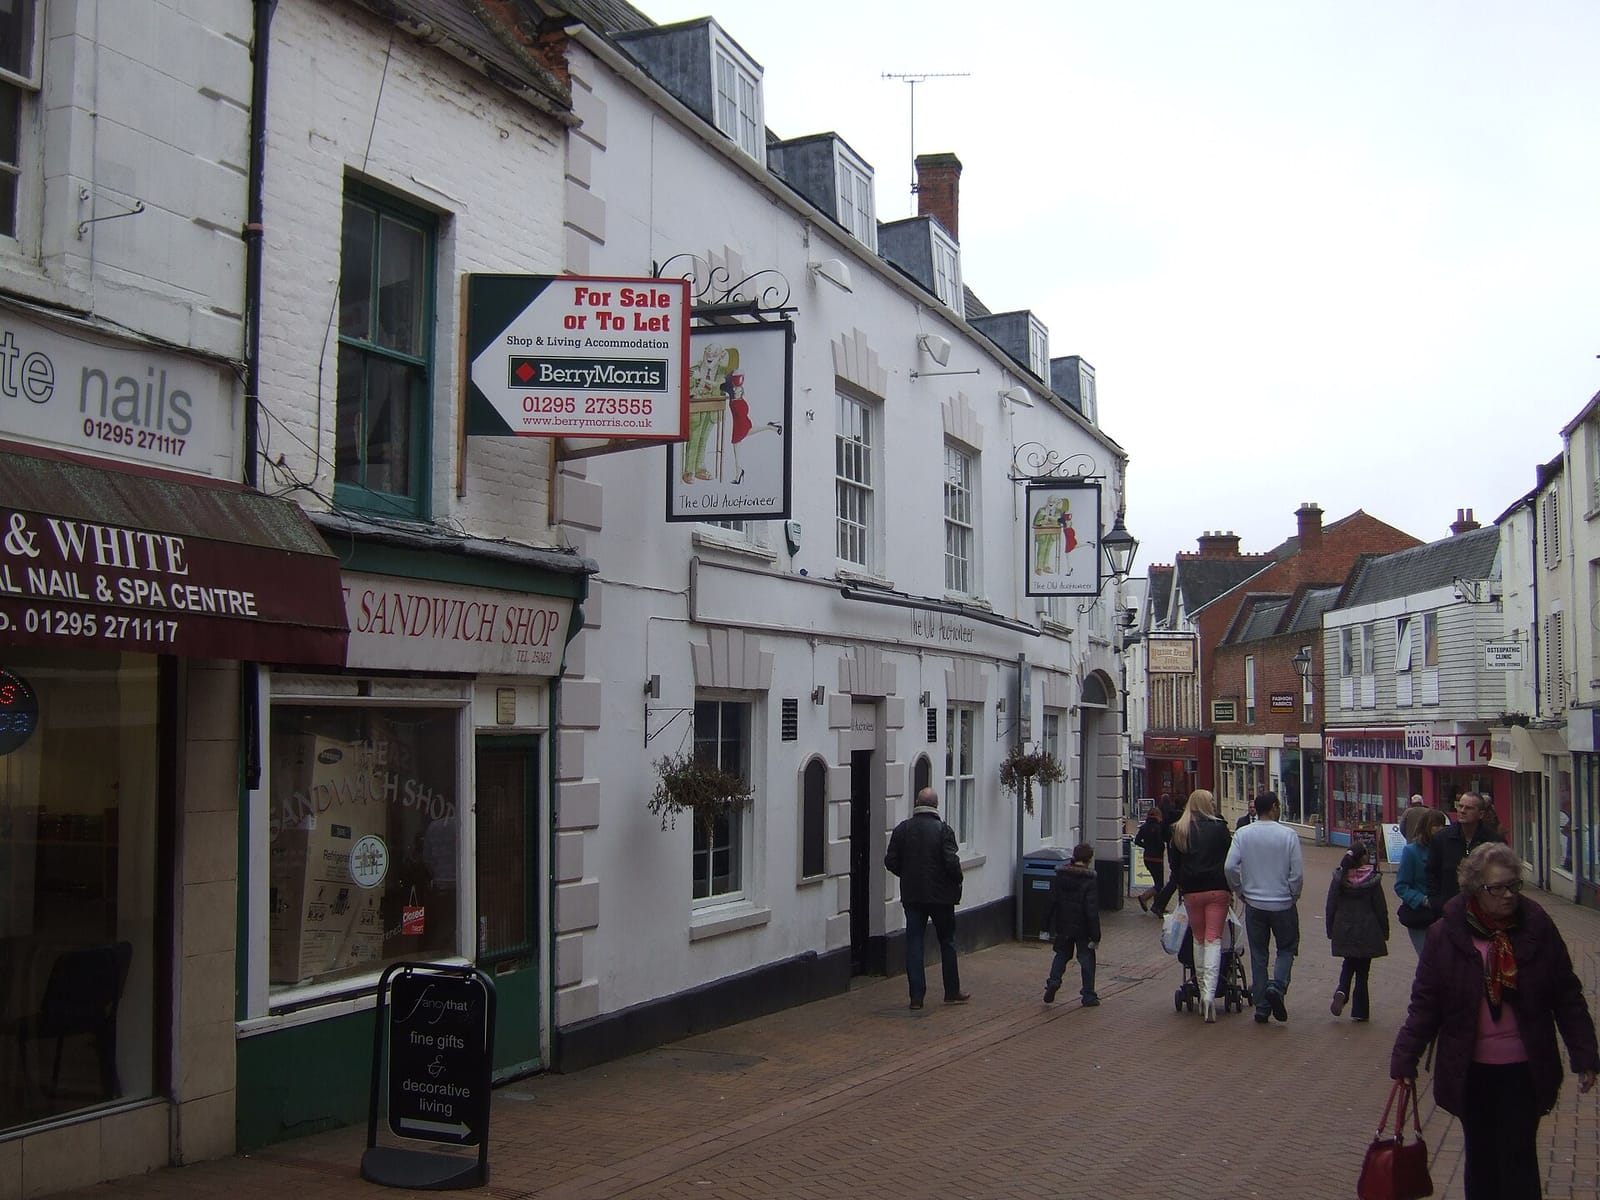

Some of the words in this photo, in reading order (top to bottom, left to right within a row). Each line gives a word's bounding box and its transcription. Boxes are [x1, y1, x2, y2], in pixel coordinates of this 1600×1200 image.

[574, 287, 611, 307] For
[620, 288, 671, 308] Sale
[563, 313, 587, 331] or
[595, 312, 626, 331] To
[633, 313, 671, 332] Let
[506, 336, 533, 350] Shop
[535, 337, 544, 347] &
[546, 336, 582, 349] Living
[584, 337, 669, 350] Accommodation
[538, 363, 661, 388] BerryMorris
[79, 366, 193, 436] nails
[522, 397, 576, 415] 01295
[584, 397, 653, 416] 273555
[522, 416, 653, 429] www.berrymorris.co.uk
[83, 418, 134, 446] 01295
[137, 426, 186, 457] 271117
[679, 494, 700, 510] The
[701, 493, 720, 509] Old
[721, 494, 776, 509] Auctioneer
[4, 512, 41, 558] &
[47, 517, 190, 576] WHITE
[27, 566, 91, 600] NAIL
[95, 574, 114, 603] &
[118, 577, 168, 608] SPA
[170, 583, 259, 617] CENTRE
[25, 608, 98, 637] 01295
[104, 615, 179, 643] 271117
[356, 589, 499, 643] SANDWICH
[501, 605, 560, 647] SHOP
[1332, 738, 1385, 759] SUPERIOR
[1407, 735, 1431, 748] NAILS
[1465, 739, 1493, 762] 14
[350, 740, 389, 766] THE
[402, 779, 456, 827] SHOP
[410, 1030, 434, 1046] fine
[437, 1034, 465, 1049] gifts
[426, 1053, 447, 1078] &
[402, 1078, 471, 1098] decorative
[419, 1097, 453, 1117] living
